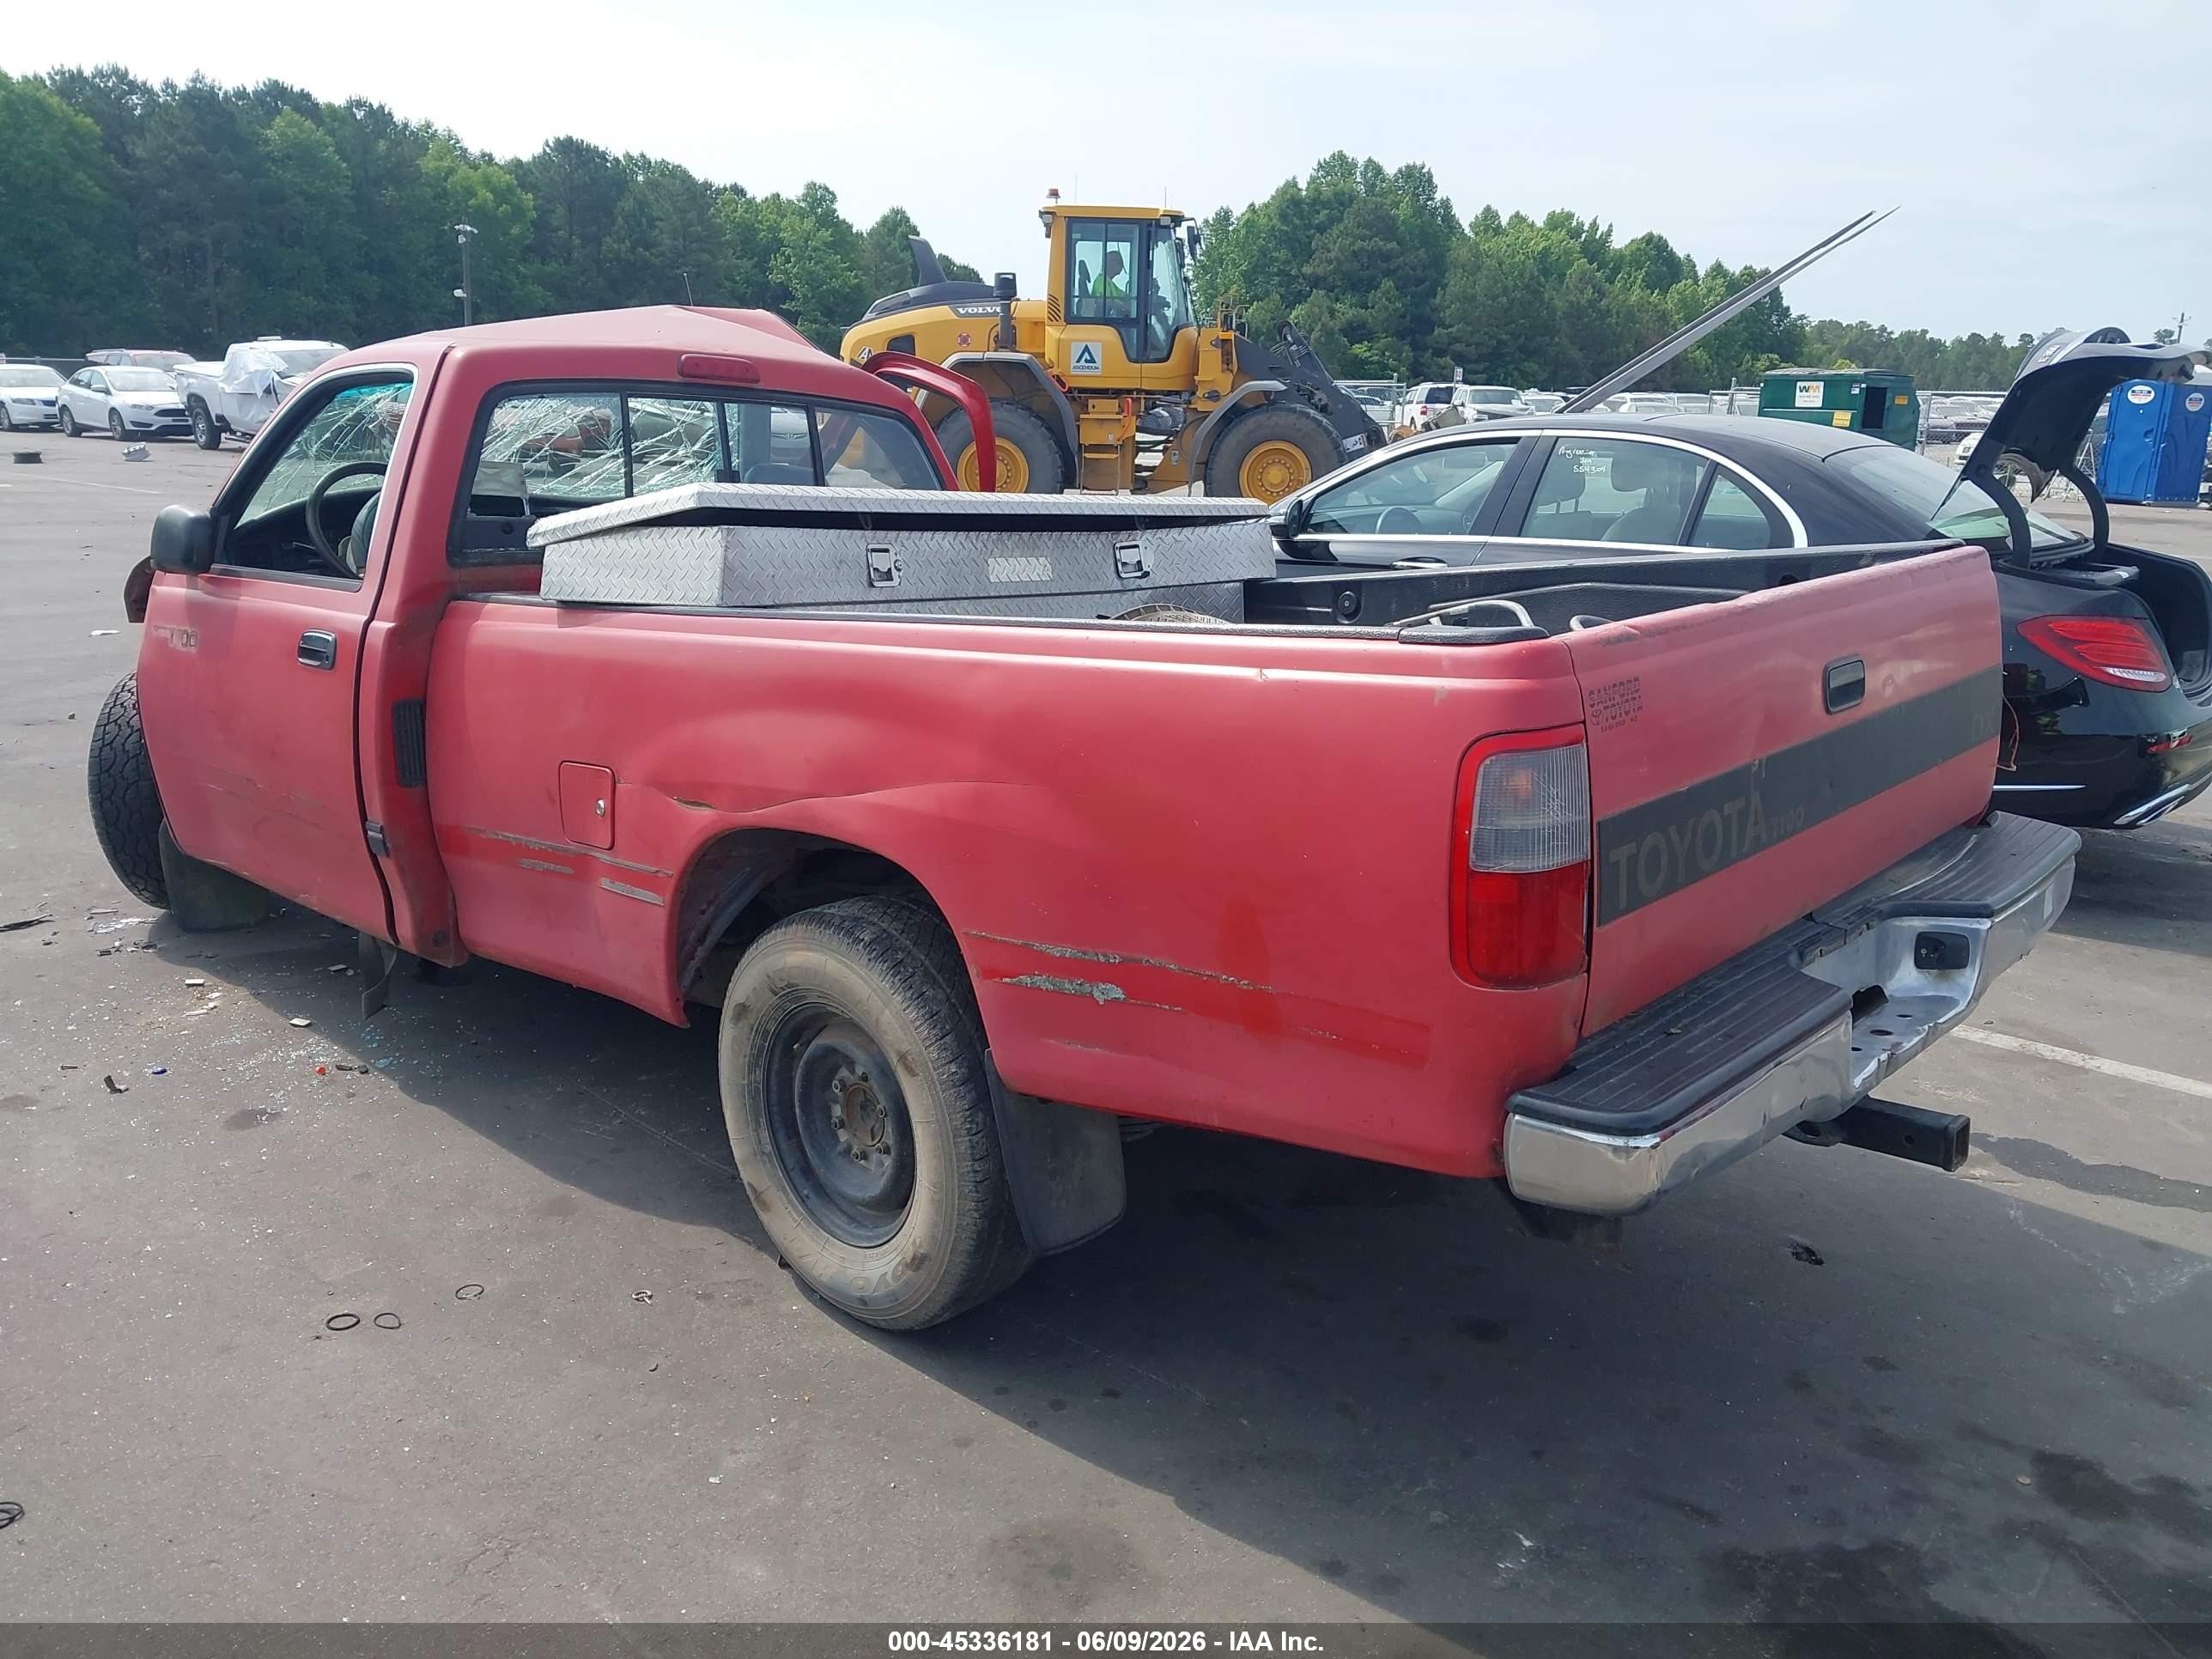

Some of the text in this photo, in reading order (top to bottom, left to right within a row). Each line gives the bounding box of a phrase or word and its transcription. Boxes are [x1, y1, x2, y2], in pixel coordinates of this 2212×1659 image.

[1589, 676, 1641, 708] SANFORD
[1602, 695, 1644, 723] TOYOTA
[1608, 788, 1768, 910] TOYOTA
